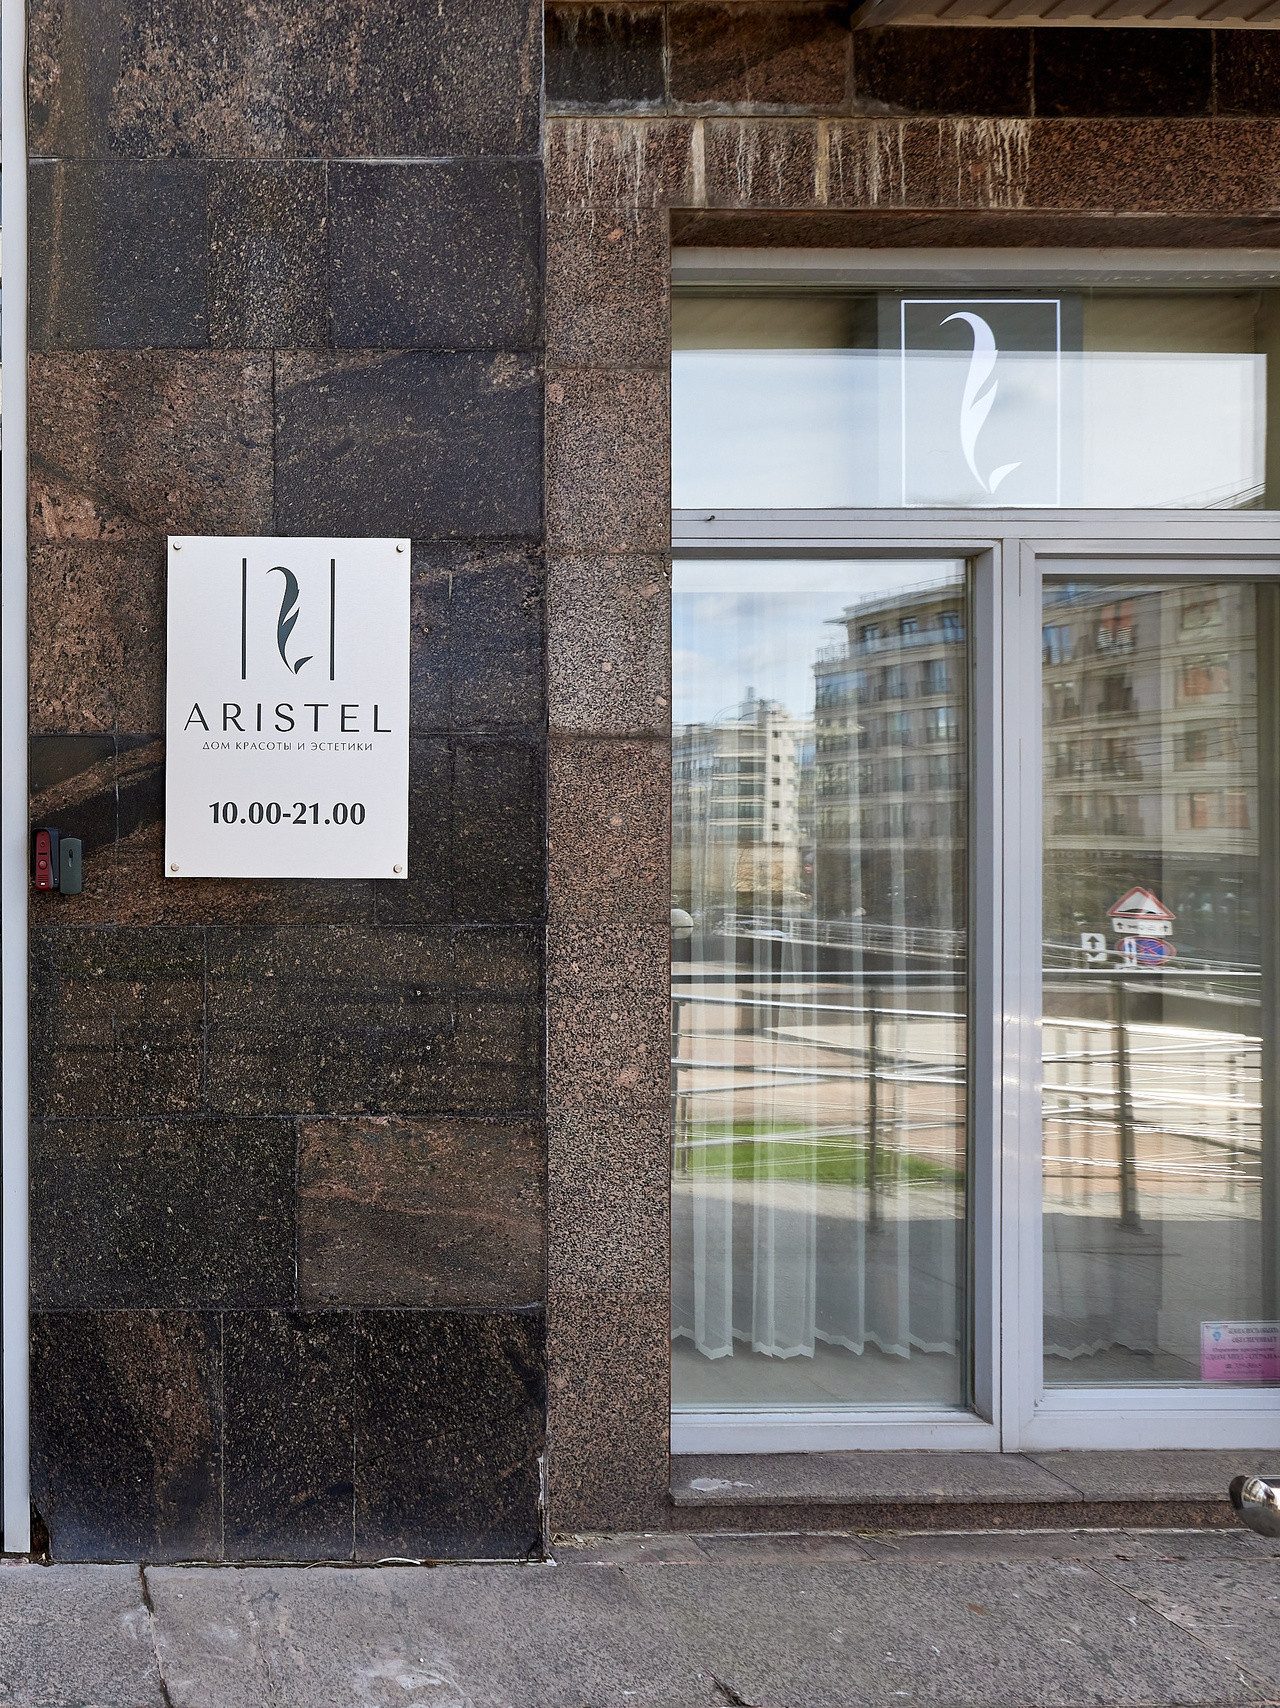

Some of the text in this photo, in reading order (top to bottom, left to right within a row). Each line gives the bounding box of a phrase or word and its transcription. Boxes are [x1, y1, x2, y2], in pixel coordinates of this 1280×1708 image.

[183, 702, 392, 733] ARISTEL
[202, 741, 374, 752] ДОМ КРАСОТЫ И ЭСТЕТИКИ
[208, 801, 366, 826] 10.00-21.00
